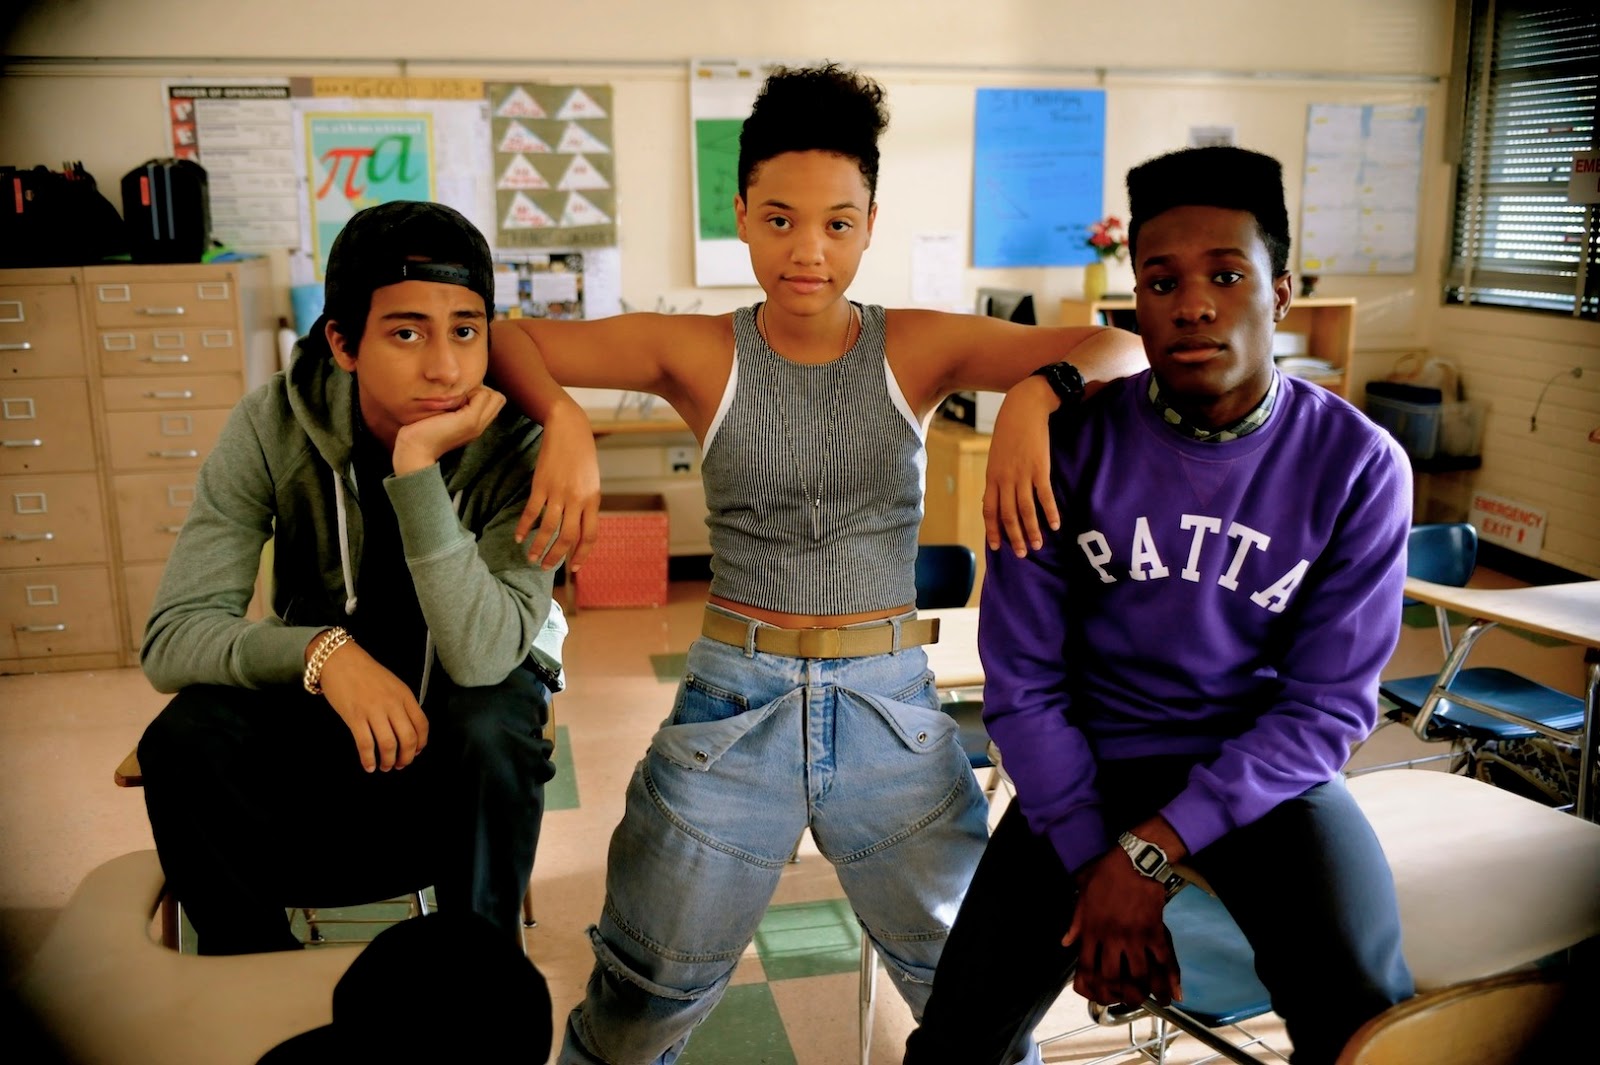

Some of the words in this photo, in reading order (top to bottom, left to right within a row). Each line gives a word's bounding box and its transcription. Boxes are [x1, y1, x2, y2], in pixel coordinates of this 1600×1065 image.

[1473, 495, 1543, 527] EMERGENCY
[1482, 517, 1512, 538] EXIT
[1077, 514, 1310, 613] PATTA
